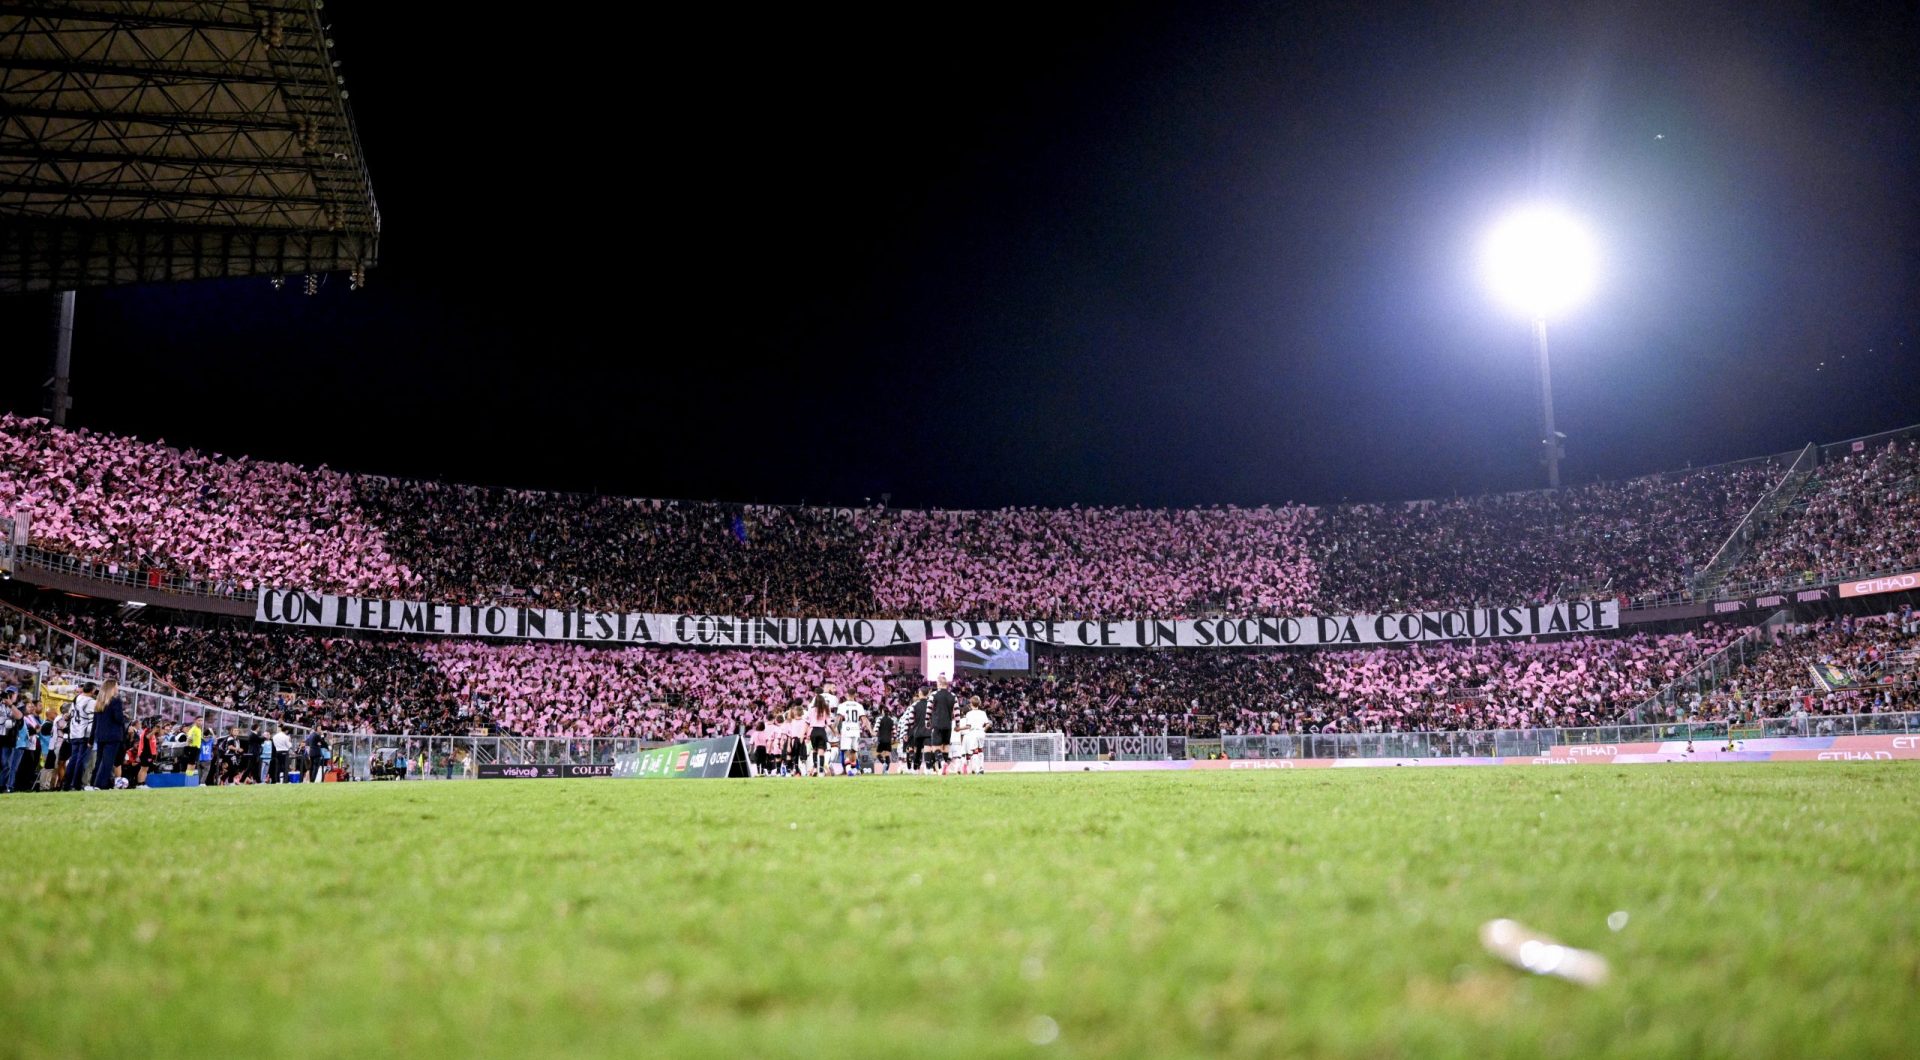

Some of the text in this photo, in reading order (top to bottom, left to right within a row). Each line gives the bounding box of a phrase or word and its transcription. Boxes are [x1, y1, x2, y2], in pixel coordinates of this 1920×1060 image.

[1855, 576, 1916, 593] ETIHAD
[1797, 589, 1821, 602] PUMA
[1714, 601, 1739, 613] PUMA
[1756, 595, 1780, 608] PUMA
[263, 589, 323, 624] CON
[336, 596, 506, 635] L'ELMETTO
[517, 606, 546, 638] IN
[558, 608, 652, 641] TESTA
[675, 615, 875, 645] CONTINUIAMO
[890, 621, 911, 644] A
[923, 620, 1066, 643] LOTTARE
[1136, 619, 1177, 646] UN
[1193, 617, 1301, 645] SOGNO
[1317, 617, 1360, 643] DA
[1374, 601, 1613, 641] CONQUISTARE
[846, 710, 858, 723] 10
[202, 745, 210, 755] 12
[1570, 745, 1618, 756] ETIHAD
[1818, 751, 1893, 761] ETIHAD
[572, 766, 607, 775] COLET
[1230, 761, 1294, 769] ETIHAD
[503, 767, 530, 776] visiva
